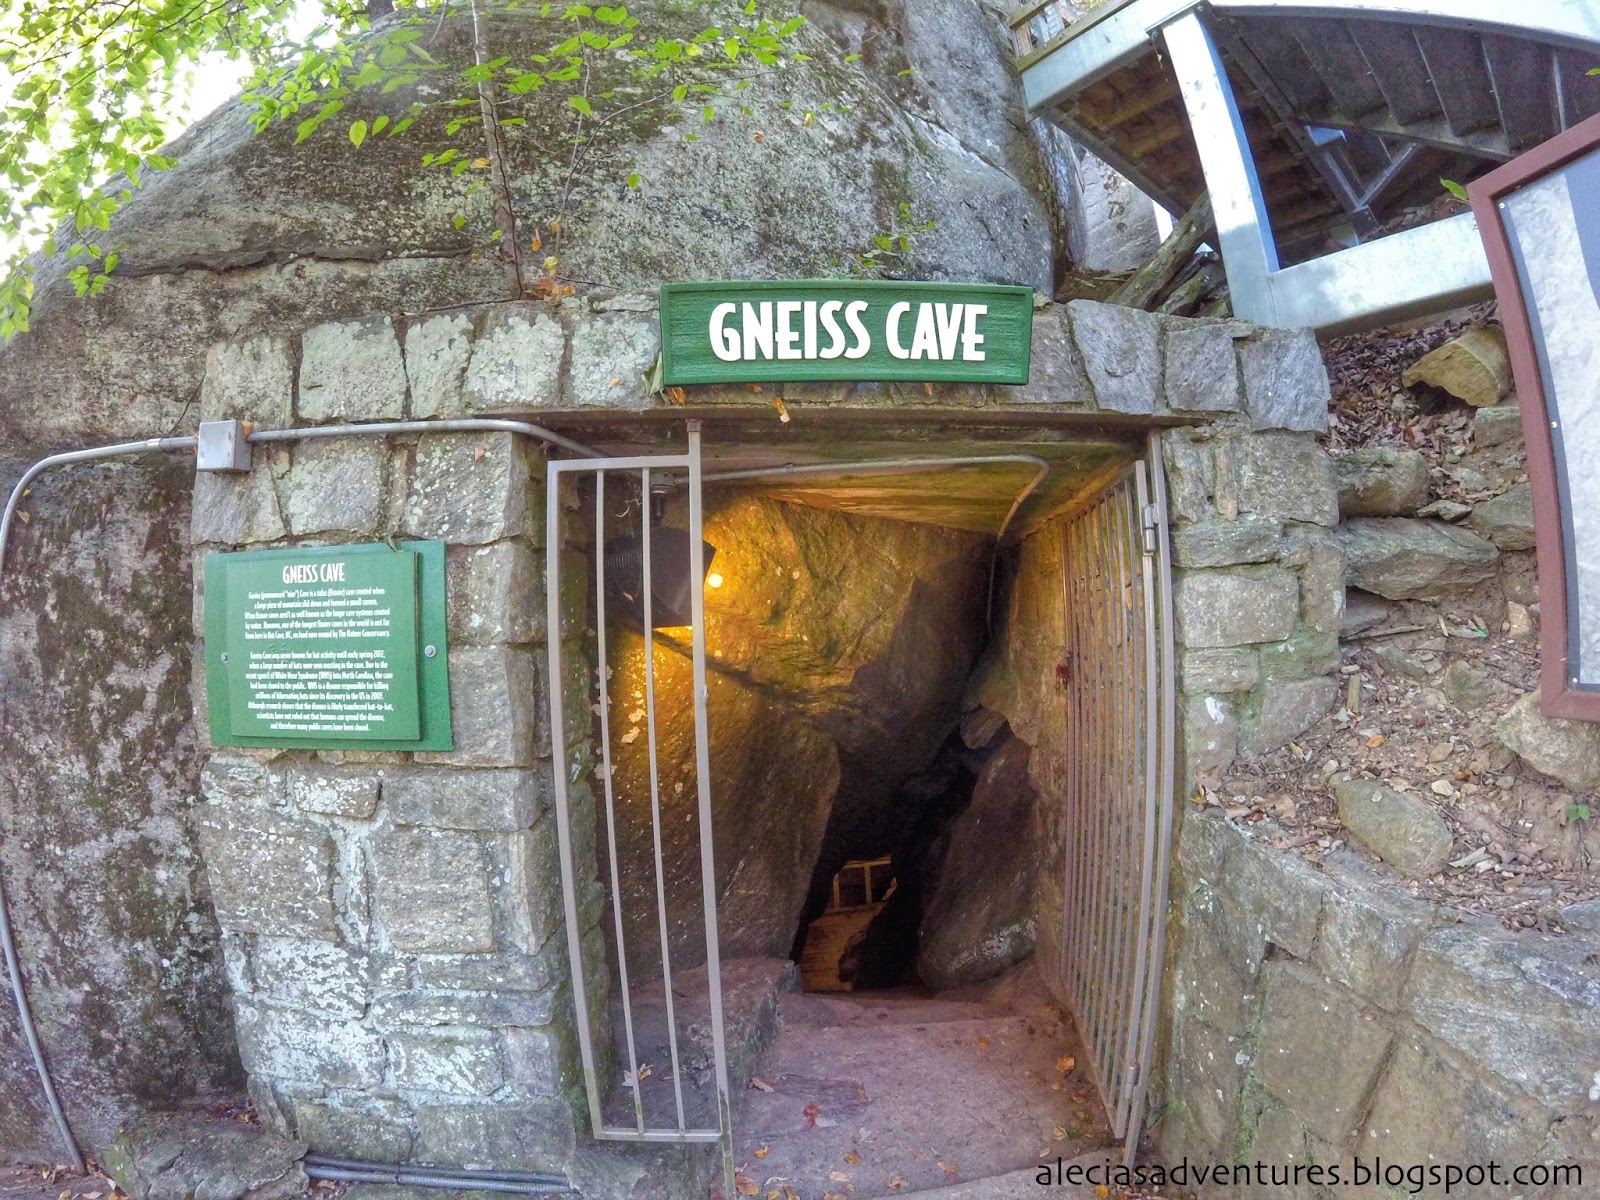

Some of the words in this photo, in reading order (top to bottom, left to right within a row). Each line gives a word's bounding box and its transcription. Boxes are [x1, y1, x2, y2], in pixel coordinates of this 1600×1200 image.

[709, 300, 871, 361] GNEISS
[885, 301, 988, 361] CAVE
[282, 564, 318, 584] GNEISS
[320, 562, 346, 582] CAVE
